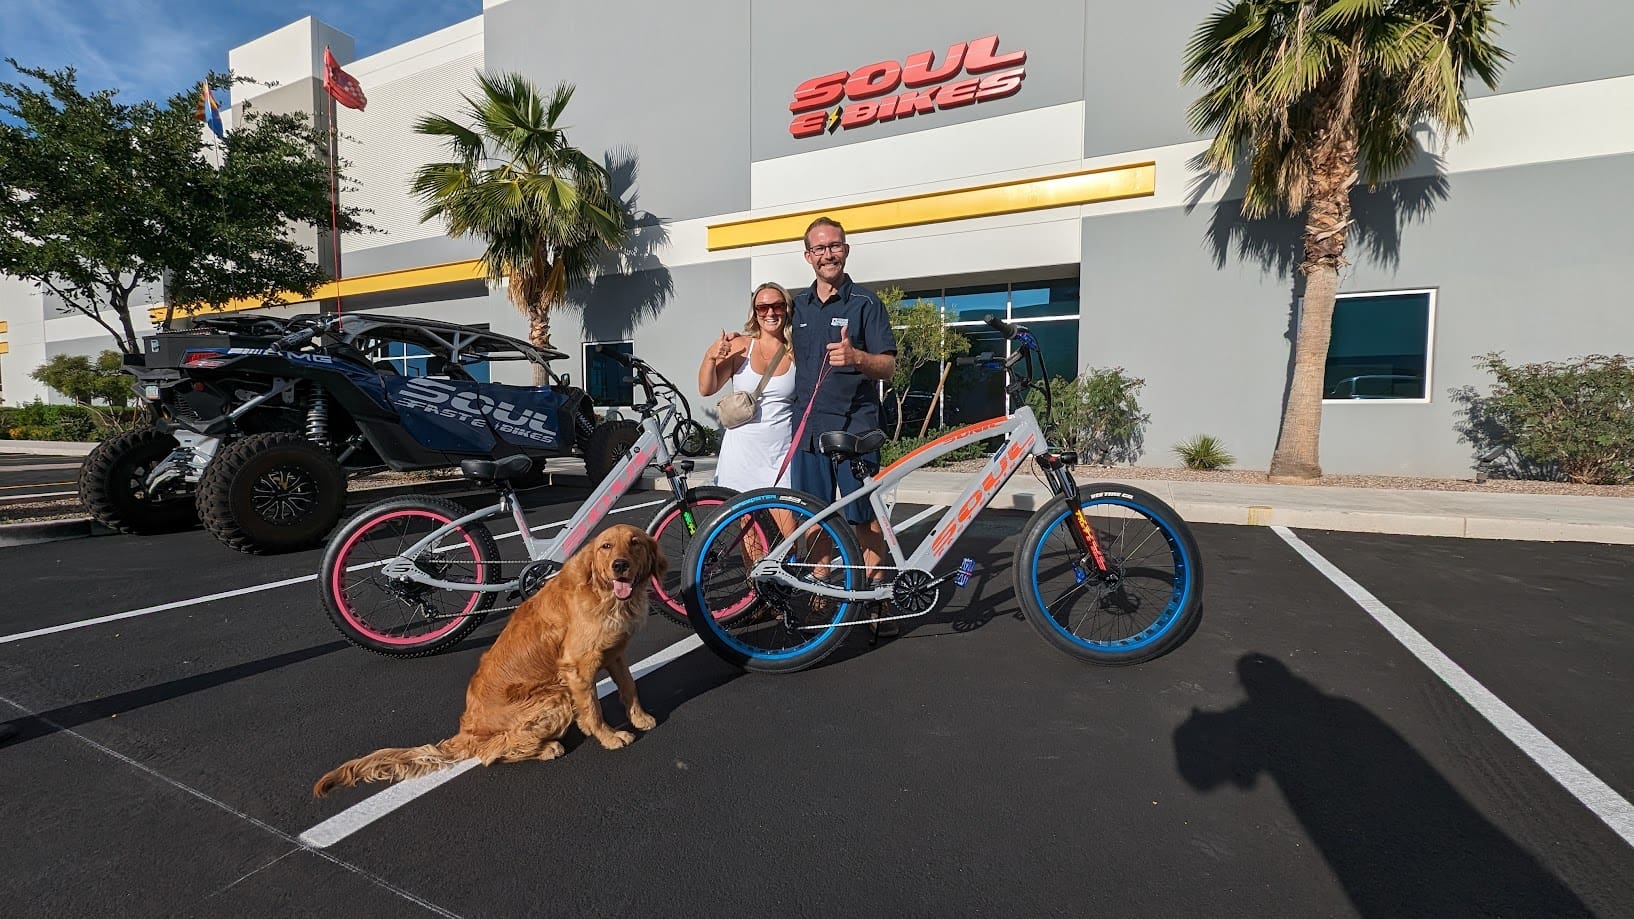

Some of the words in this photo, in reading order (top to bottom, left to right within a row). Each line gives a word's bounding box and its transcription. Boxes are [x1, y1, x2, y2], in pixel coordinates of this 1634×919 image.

[789, 34, 1027, 114] SOUL
[840, 67, 1026, 130] BIKES
[399, 377, 557, 437] SOUL
[562, 443, 658, 557] SOUL
[931, 433, 1035, 557] SOUL
